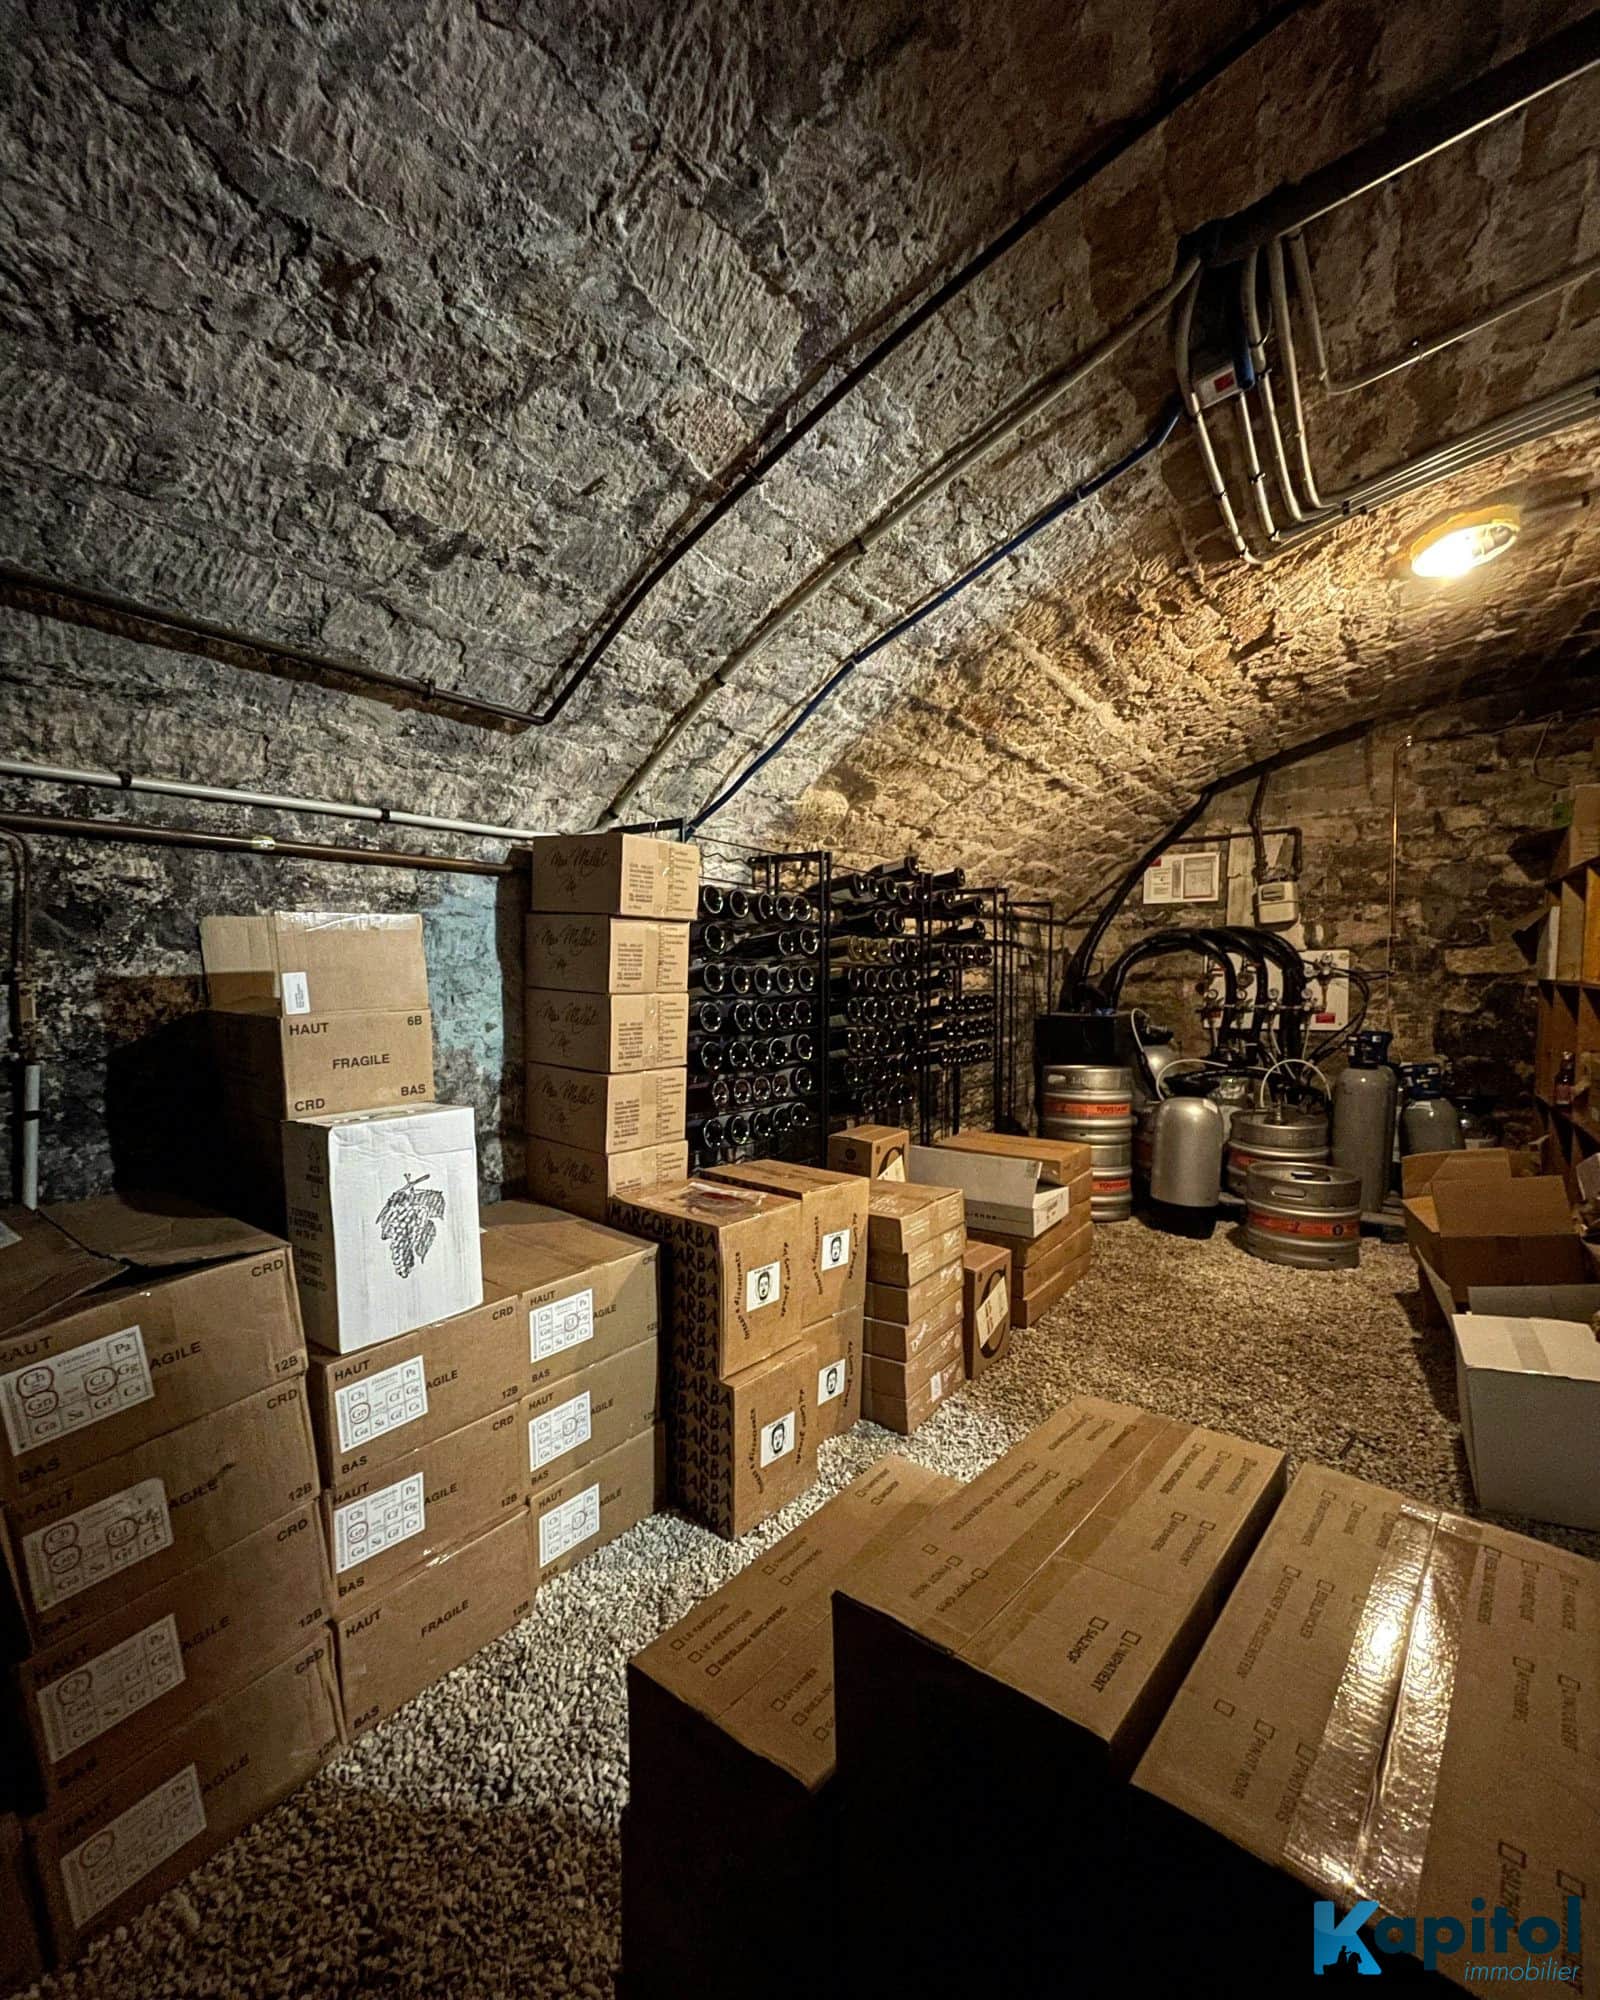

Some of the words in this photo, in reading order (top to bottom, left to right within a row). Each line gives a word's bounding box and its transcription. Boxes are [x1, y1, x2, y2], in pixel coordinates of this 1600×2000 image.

[289, 1023, 329, 1036] HAUT
[407, 1015, 423, 1026] 6B
[332, 1053, 391, 1070] FRAGILE
[401, 1084, 426, 1097] BAS
[294, 1098, 325, 1112] CRD
[251, 1258, 284, 1279] CRD
[530, 1290, 556, 1306] HAUT
[492, 1305, 514, 1321] CRD
[594, 1303, 617, 1319] AGILE
[150, 1340, 202, 1371] AGILE
[273, 1355, 299, 1374] 12B
[335, 1360, 371, 1381] HAUT
[426, 1369, 458, 1391] AGILE
[531, 1368, 551, 1382] BAS
[266, 1387, 298, 1410] CRD
[502, 1385, 519, 1400] 12B
[528, 1392, 554, 1410] HAUT
[591, 1399, 614, 1416] AGILE
[492, 1415, 515, 1432] CRD
[342, 1455, 368, 1474] BAS
[532, 1470, 549, 1486] BAS
[168, 1480, 220, 1509] AGILE
[287, 1483, 313, 1503] 12B
[332, 1482, 369, 1504] HAUT
[424, 1483, 458, 1504] AGILE
[501, 1492, 518, 1507] 12B
[276, 1518, 309, 1543] CRD
[338, 1576, 365, 1597] BAS
[299, 1607, 323, 1628] 12B
[345, 1608, 382, 1638] HAUT
[421, 1599, 469, 1637] FRAGILE
[182, 1616, 231, 1652] AGILE
[1065, 1626, 1100, 1664] SALZHOF
[294, 1647, 325, 1675] CRD
[353, 1704, 380, 1729] BAS
